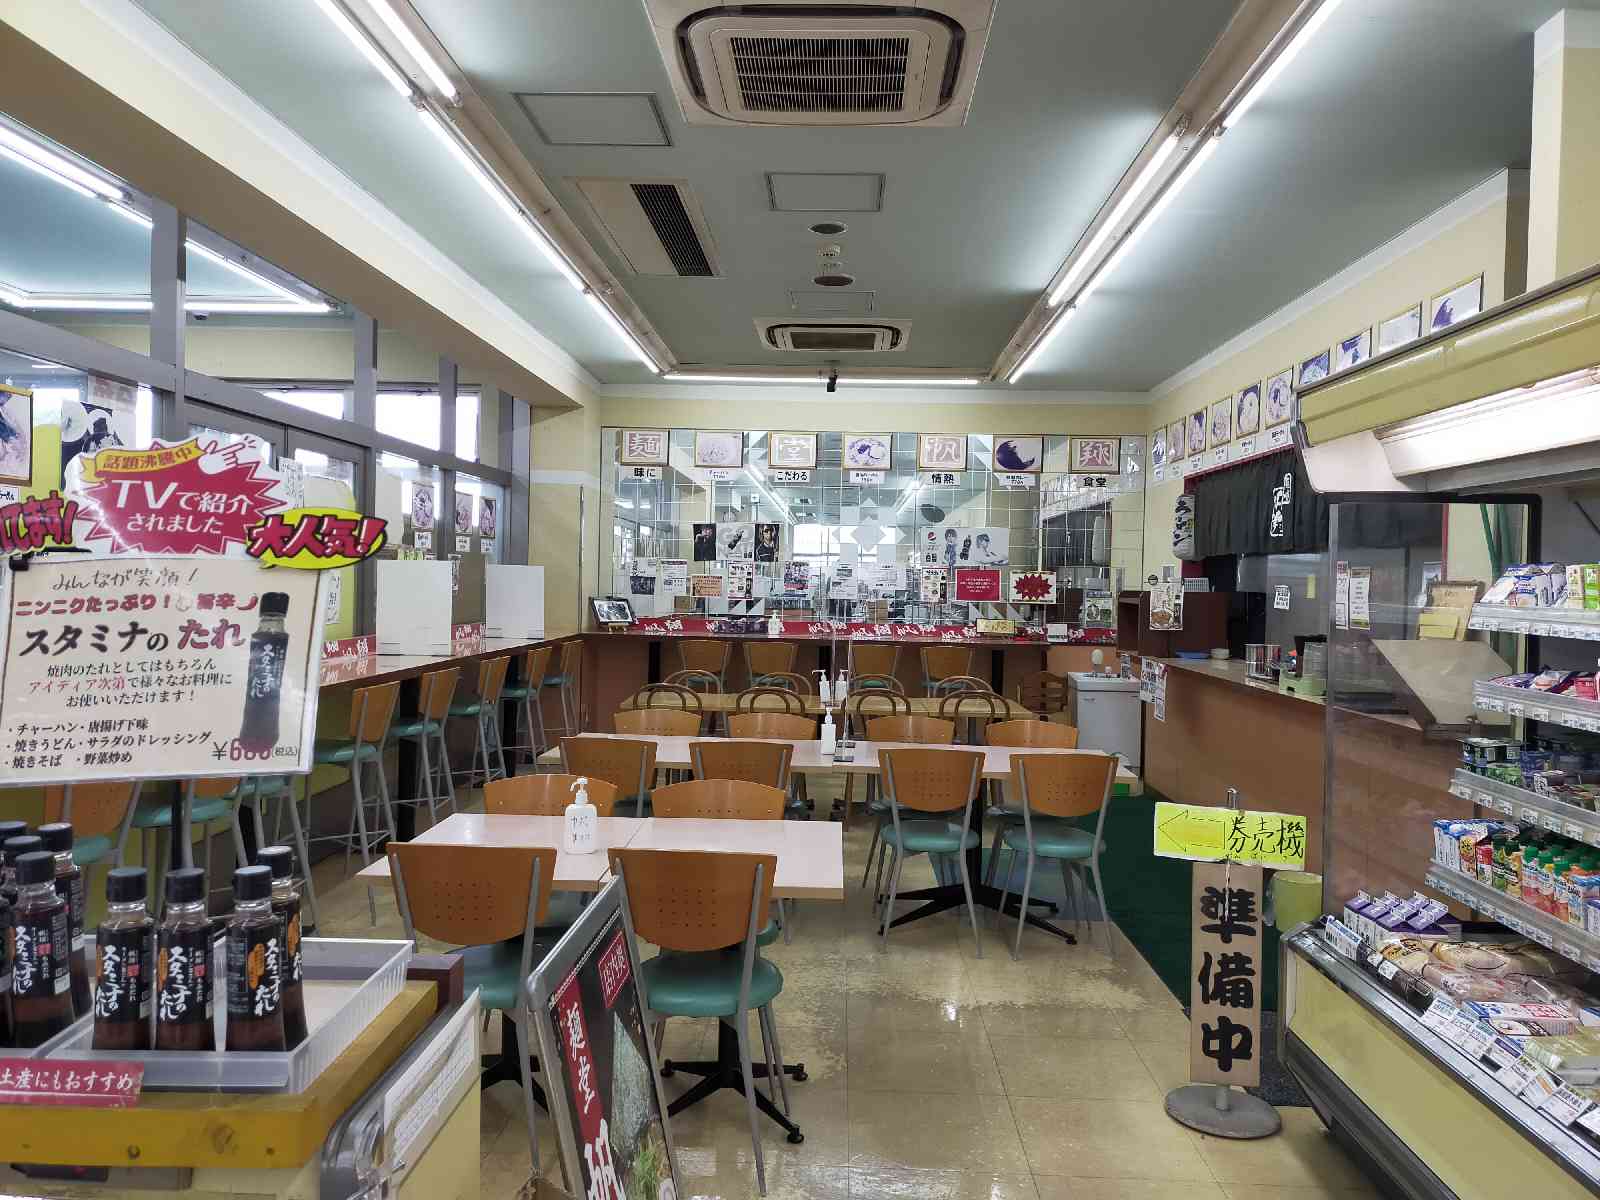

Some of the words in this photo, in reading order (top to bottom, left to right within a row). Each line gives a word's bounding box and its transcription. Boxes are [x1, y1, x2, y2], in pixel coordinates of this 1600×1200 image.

[103, 446, 193, 471] 話題沸騰中
[633, 467, 657, 478] 味に
[776, 470, 809, 481] こだわる
[931, 473, 955, 485] 情熱
[1083, 476, 1107, 488] 食堂
[111, 479, 254, 516] TVで紹介
[126, 512, 224, 535] されました
[248, 515, 386, 557] 大人気！
[19, 618, 245, 656] スタミナのたれ
[47, 659, 217, 678] 焼肉のたれとしてはもちろん
[28, 673, 233, 693] アイディア次第で様々なお料理に
[65, 690, 195, 708] お使いいただけます！
[1227, 815, 1306, 859] 券売機
[1198, 886, 1258, 1073] 準備中
